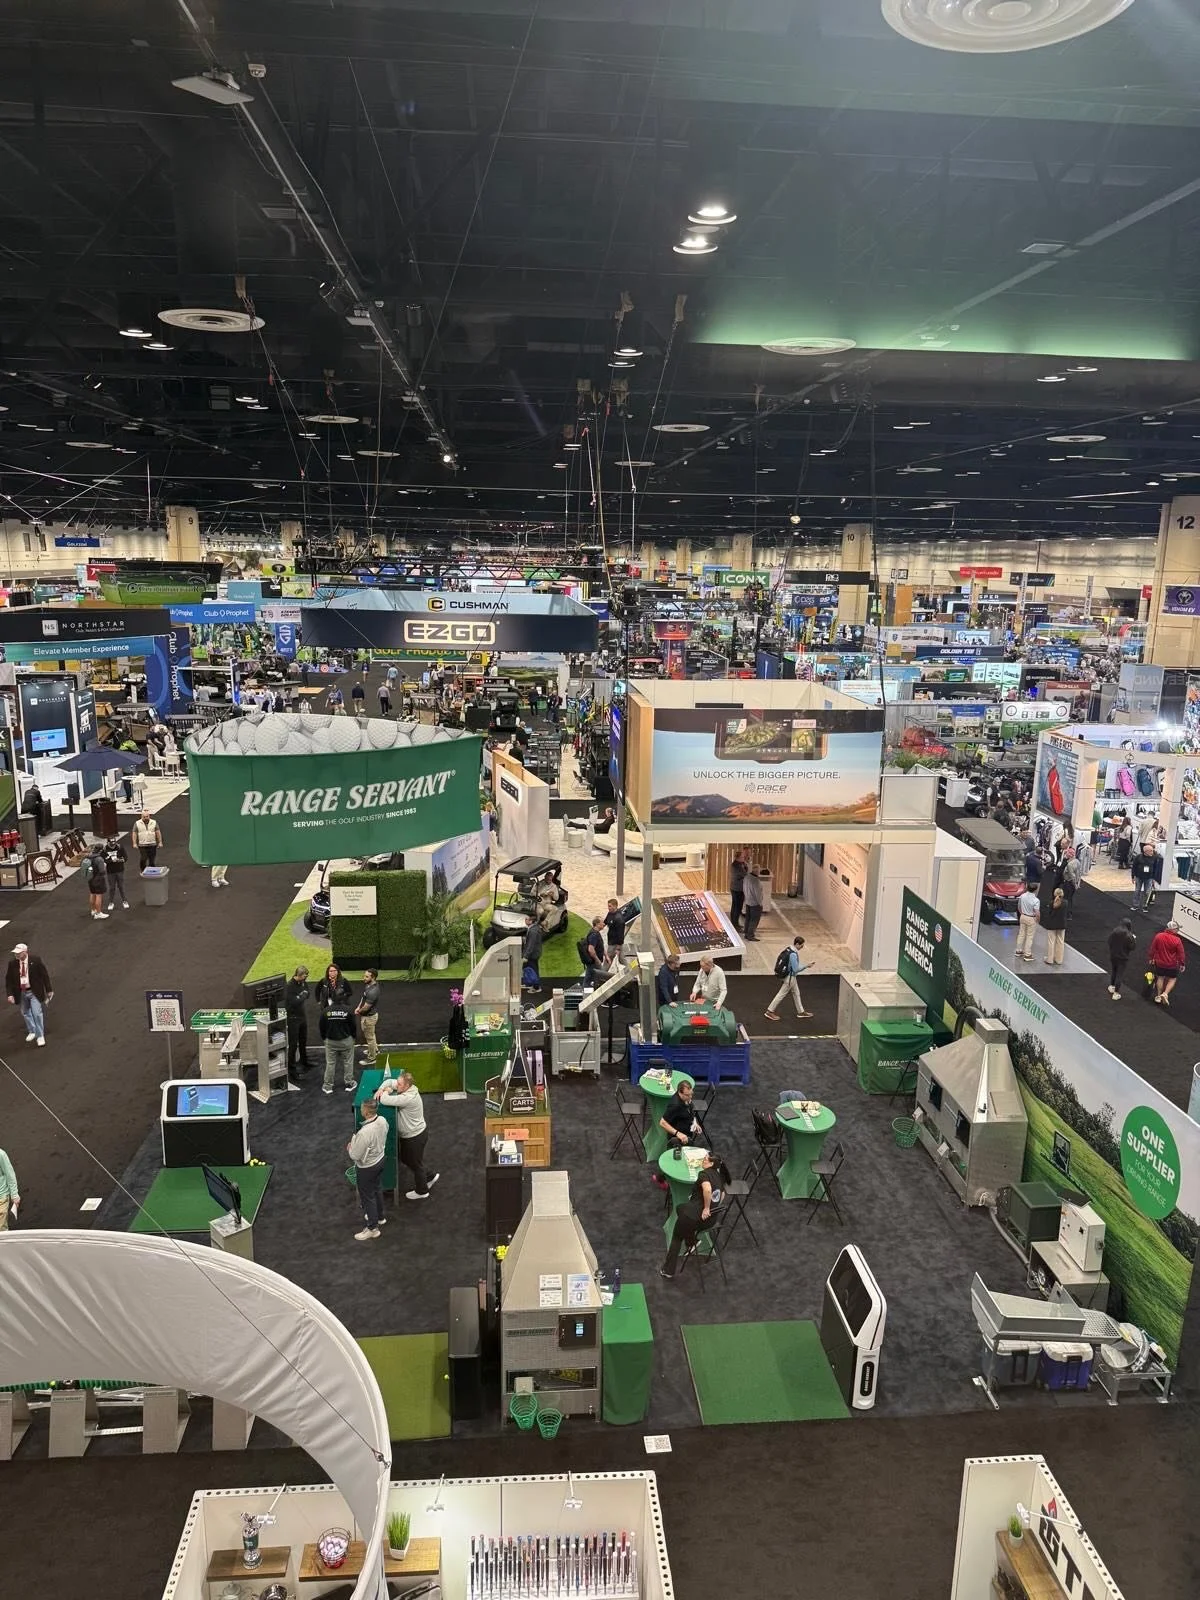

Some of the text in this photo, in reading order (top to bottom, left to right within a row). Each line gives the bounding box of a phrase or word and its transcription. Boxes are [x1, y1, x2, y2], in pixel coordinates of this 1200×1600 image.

[188, 517, 194, 525] 9
[1177, 516, 1195, 530] 12
[225, 609, 250, 617] Prophet
[449, 602, 509, 610] CUSHMAN
[62, 620, 125, 629] NORTHSTAR
[33, 644, 130, 656] Elevate Member Experience
[168, 631, 177, 654] Club
[406, 648, 465, 656] PRODUCTS
[170, 665, 180, 701] Prophet
[693, 771, 841, 779] UNLOCK THE BIGGER PICTURE.
[240, 787, 342, 816] RANGE
[292, 819, 324, 828] SERVING
[325, 818, 337, 826] THE
[338, 816, 356, 825] GOLF
[356, 813, 385, 823] INDUSTRY
[386, 810, 403, 818] SINCE
[906, 906, 929, 936] RANGE
[905, 923, 935, 958] SERVANT
[904, 940, 934, 978] AMERICA
[988, 967, 1049, 1024] RANGE SERVANT
[1141, 1125, 1165, 1154] ONE
[1126, 1131, 1176, 1186] SUPPLIER
[1126, 1163, 1167, 1209] DRIVING RANGE
[1135, 1159, 1161, 1189] FOR YOUR
